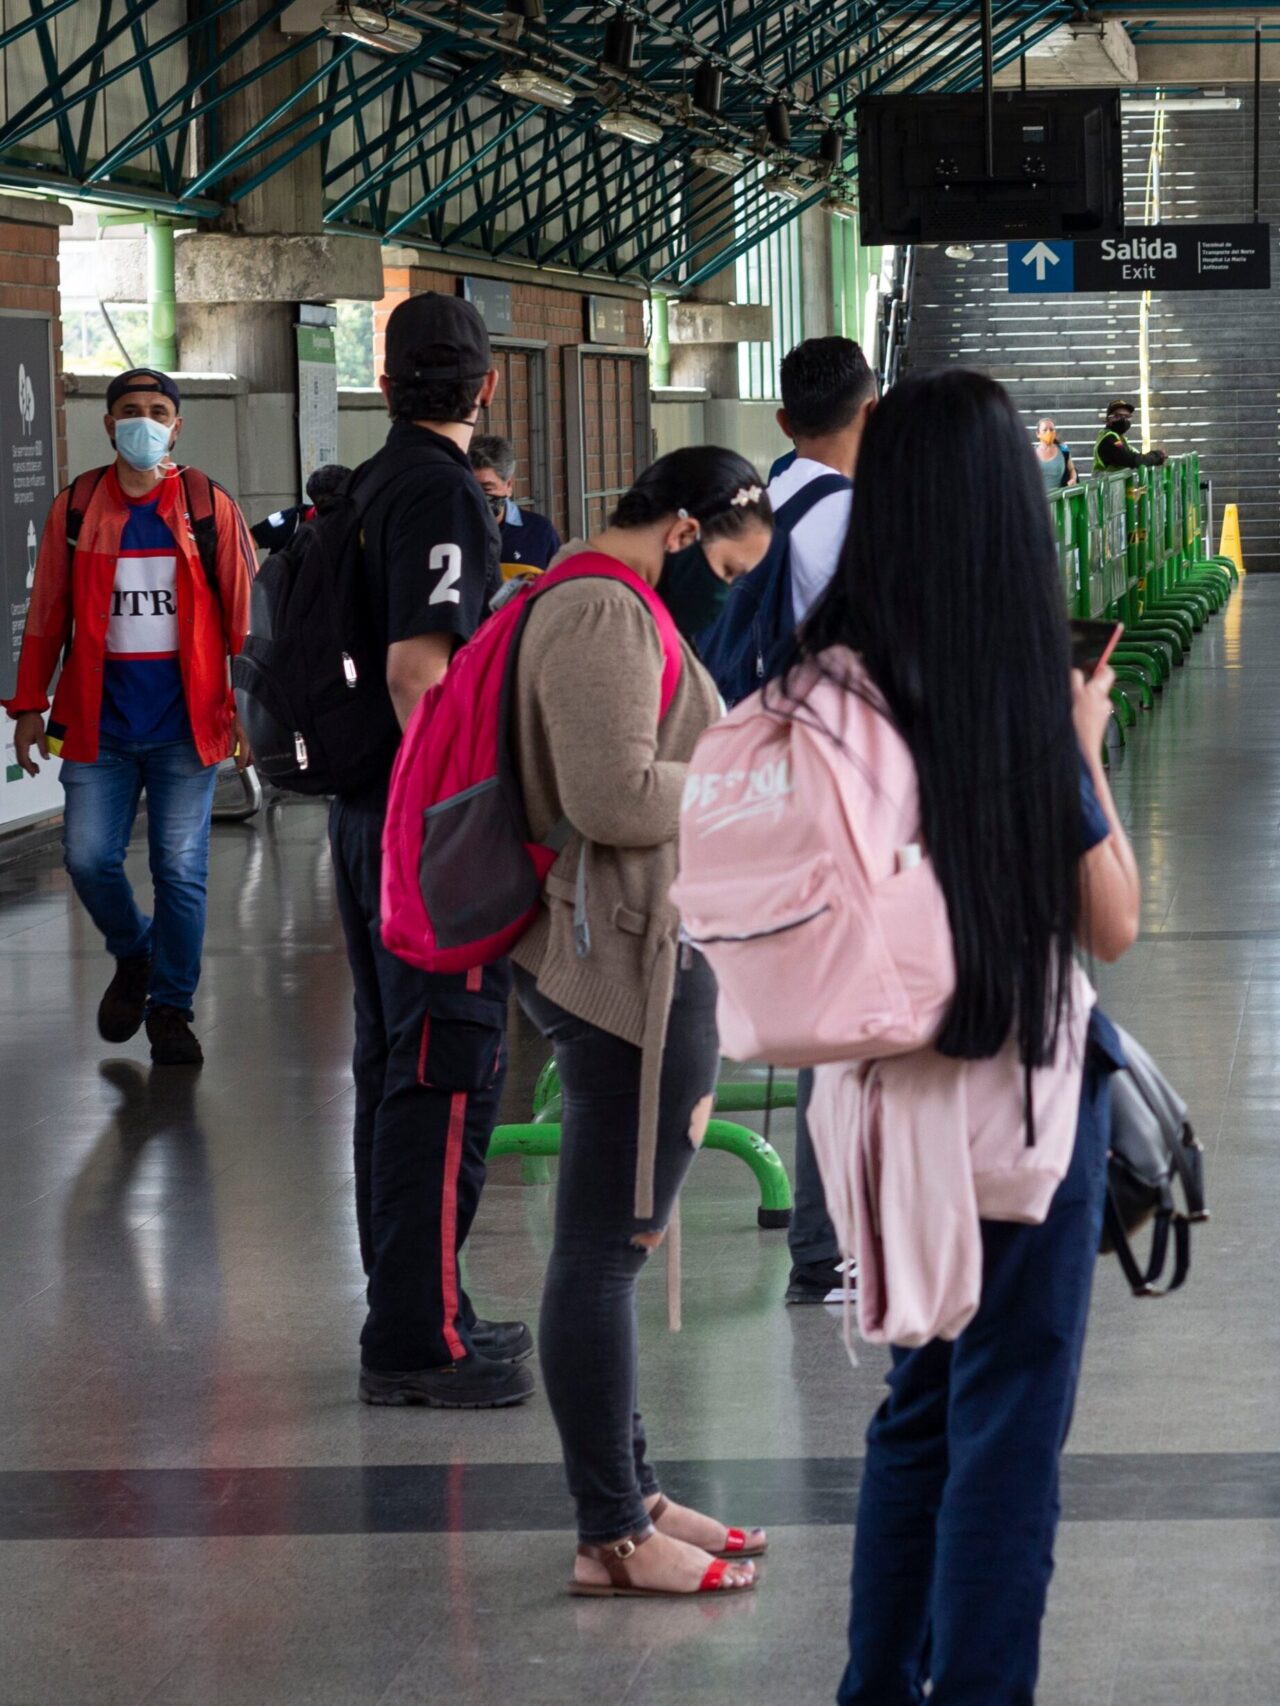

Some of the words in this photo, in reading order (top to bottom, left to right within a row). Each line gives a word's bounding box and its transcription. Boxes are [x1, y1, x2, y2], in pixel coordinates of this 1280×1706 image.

[1101, 237, 1177, 260] Salida
[1122, 263, 1156, 279] Exit
[428, 543, 462, 606] 2
